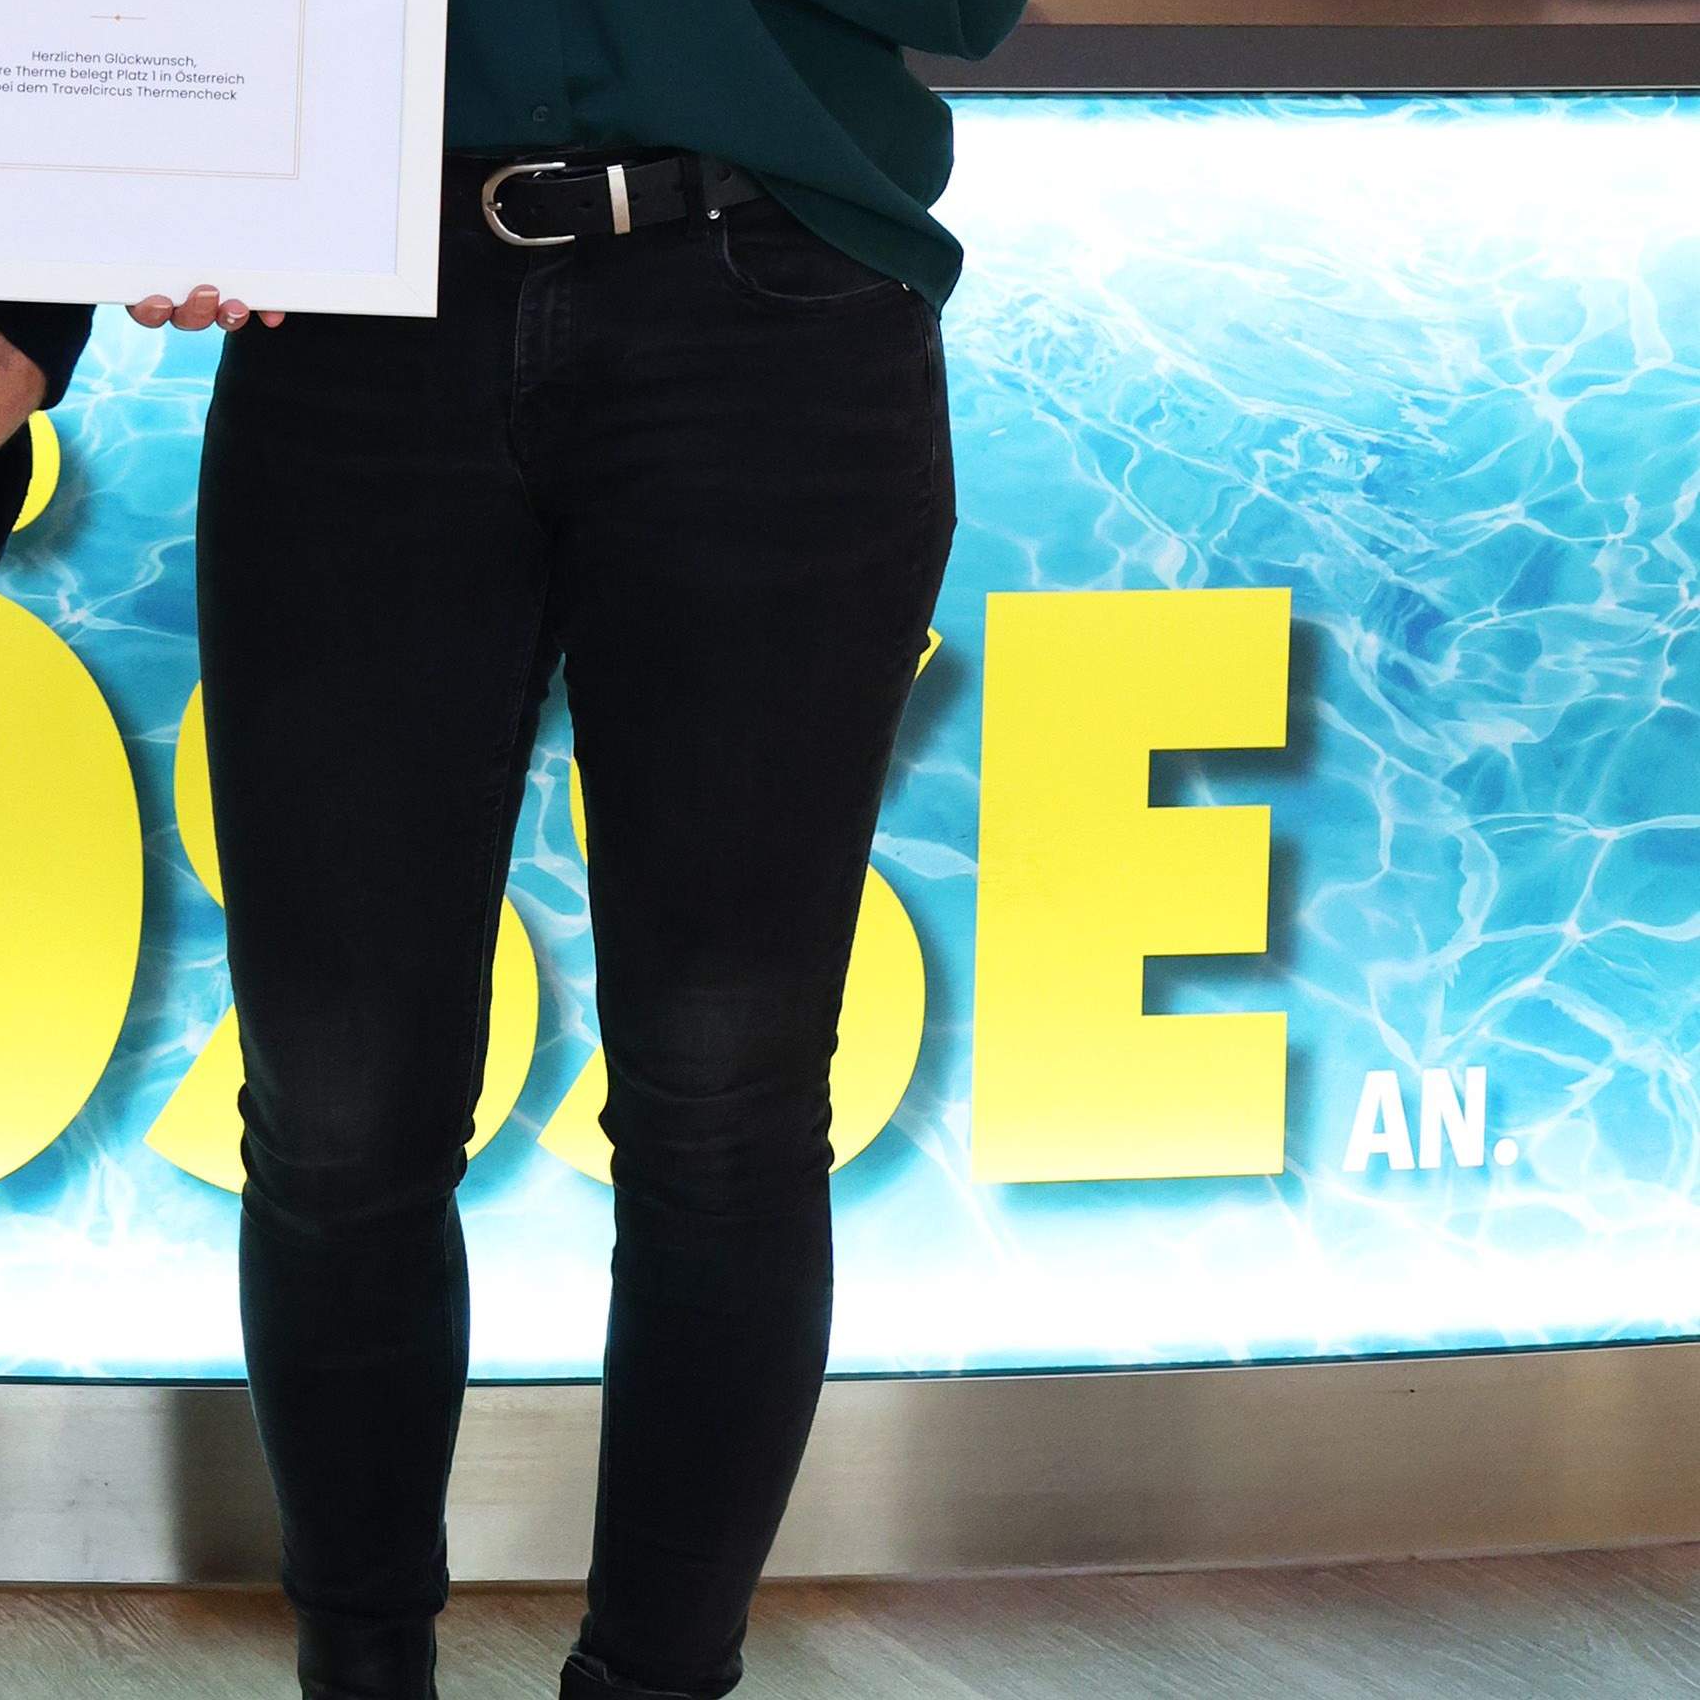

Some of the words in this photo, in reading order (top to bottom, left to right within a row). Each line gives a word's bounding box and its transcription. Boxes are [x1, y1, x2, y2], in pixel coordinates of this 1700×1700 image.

[31, 50, 101, 64] Herzlichen
[104, 52, 198, 68] Glückwunsch,
[15, 65, 67, 79] Therme
[70, 67, 113, 82] belegt
[116, 69, 148, 82] Platz
[159, 70, 172, 82] in
[174, 69, 246, 85] Österreich
[17, 81, 48, 94] dem
[52, 83, 133, 98] Travelcircus
[137, 85, 238, 101] Thermencheck
[1342, 1065, 1520, 1173] AN.
